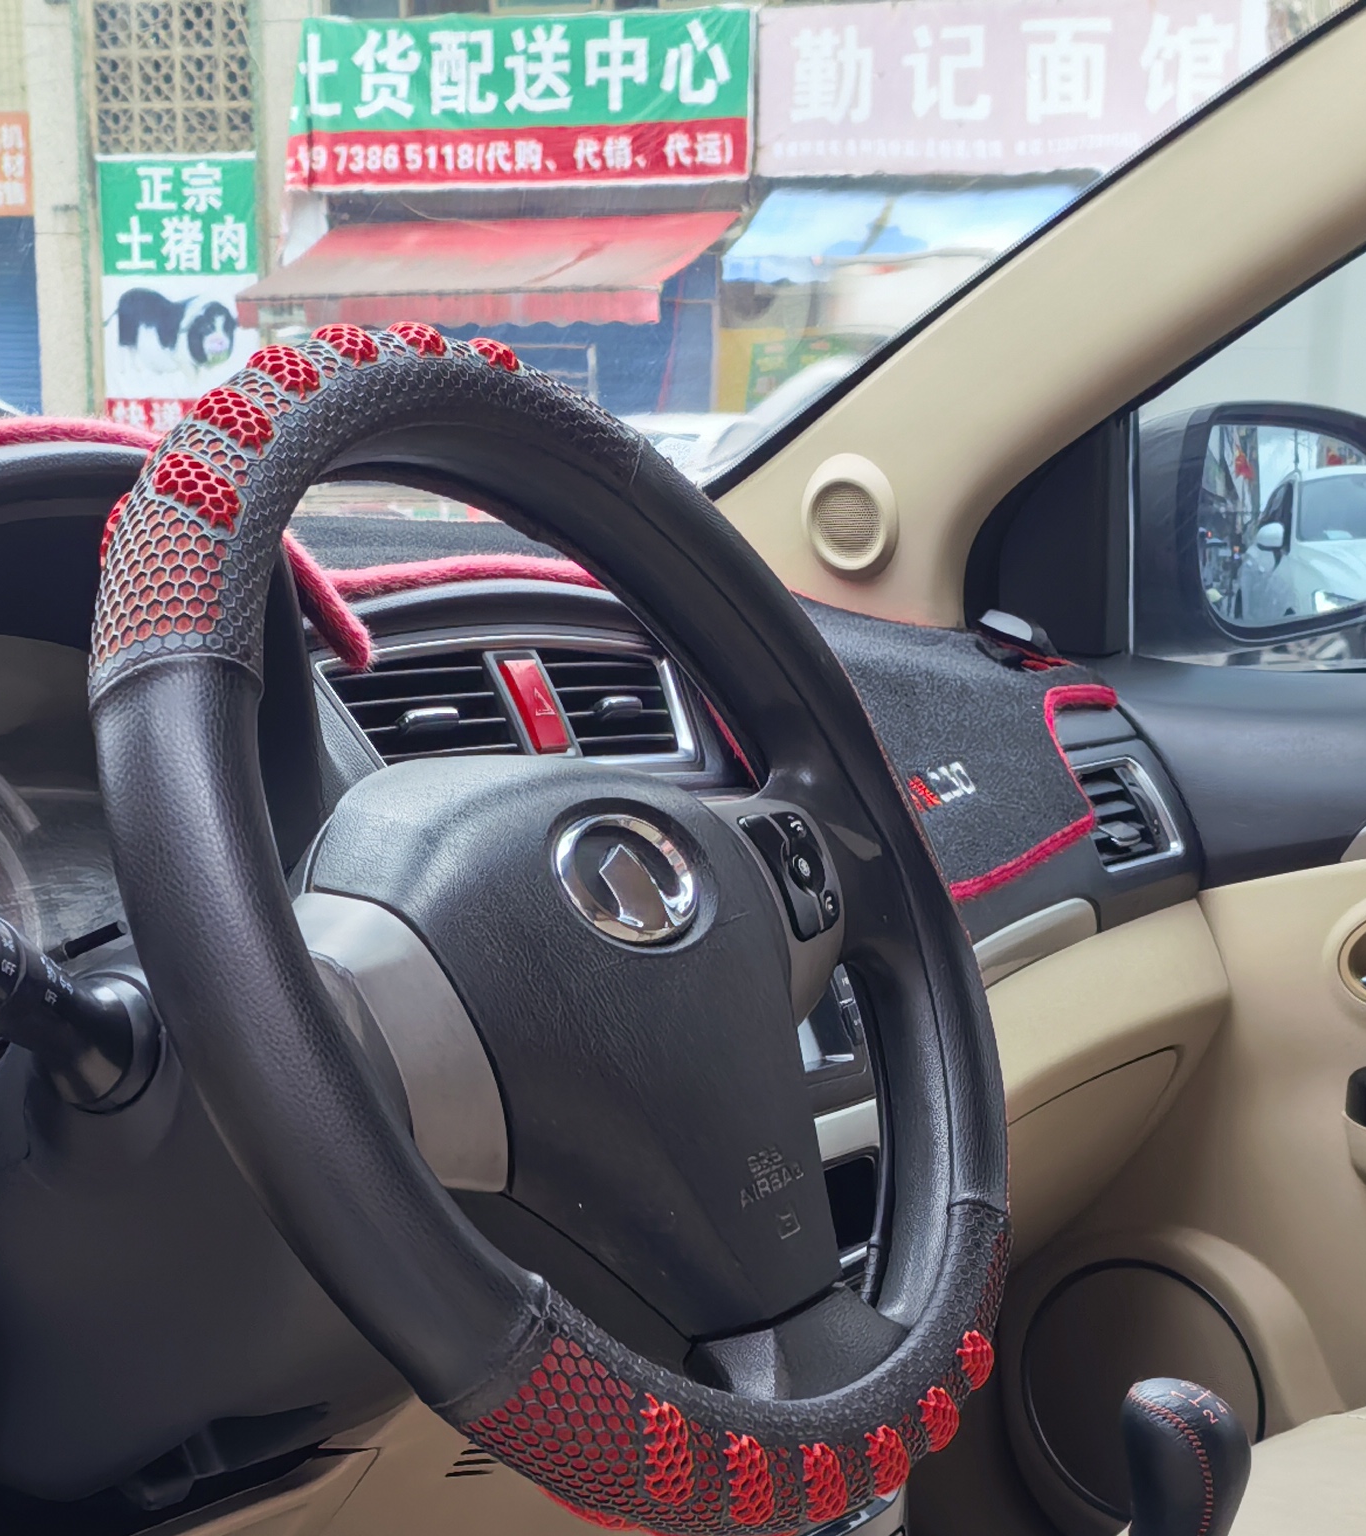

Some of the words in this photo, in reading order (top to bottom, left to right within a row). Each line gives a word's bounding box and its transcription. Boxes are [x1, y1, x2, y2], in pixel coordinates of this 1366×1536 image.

[789, 13, 1235, 126] 勤记面馆
[334, 142, 400, 174] 7386
[135, 162, 223, 212] 正宗
[115, 214, 248, 271] 土猪肉
[1202, 1409, 1219, 1424] 2
[1215, 1401, 1229, 1416] 4
